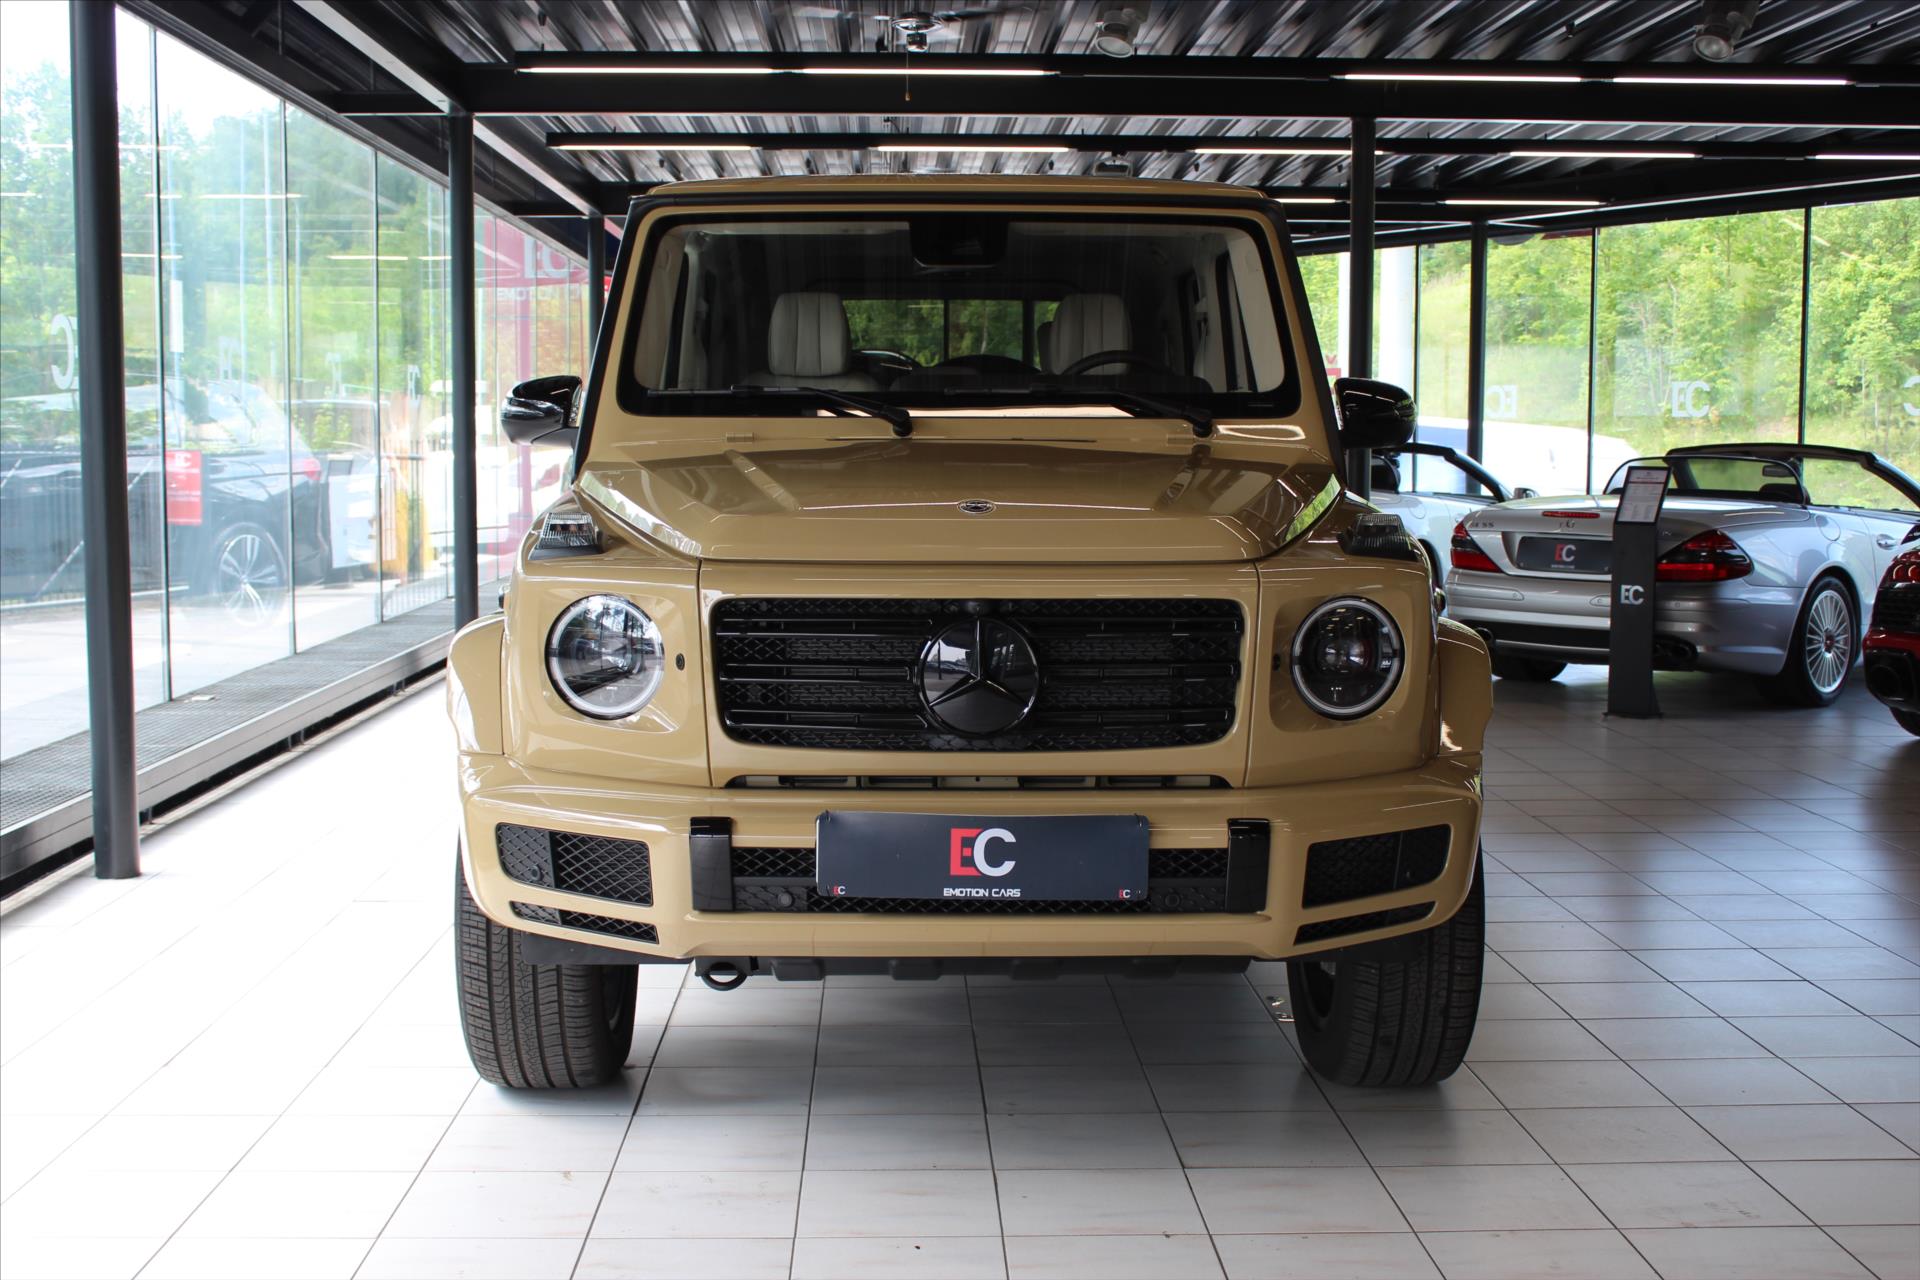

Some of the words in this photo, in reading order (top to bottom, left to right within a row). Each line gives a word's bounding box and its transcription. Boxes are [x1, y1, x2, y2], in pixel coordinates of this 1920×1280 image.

[1671, 379, 1711, 418] EC
[1554, 543, 1576, 562] EC
[1620, 584, 1645, 606] EC
[950, 827, 1017, 877] EC
[943, 887, 989, 897] EMOTION
[991, 888, 1021, 897] CARS
